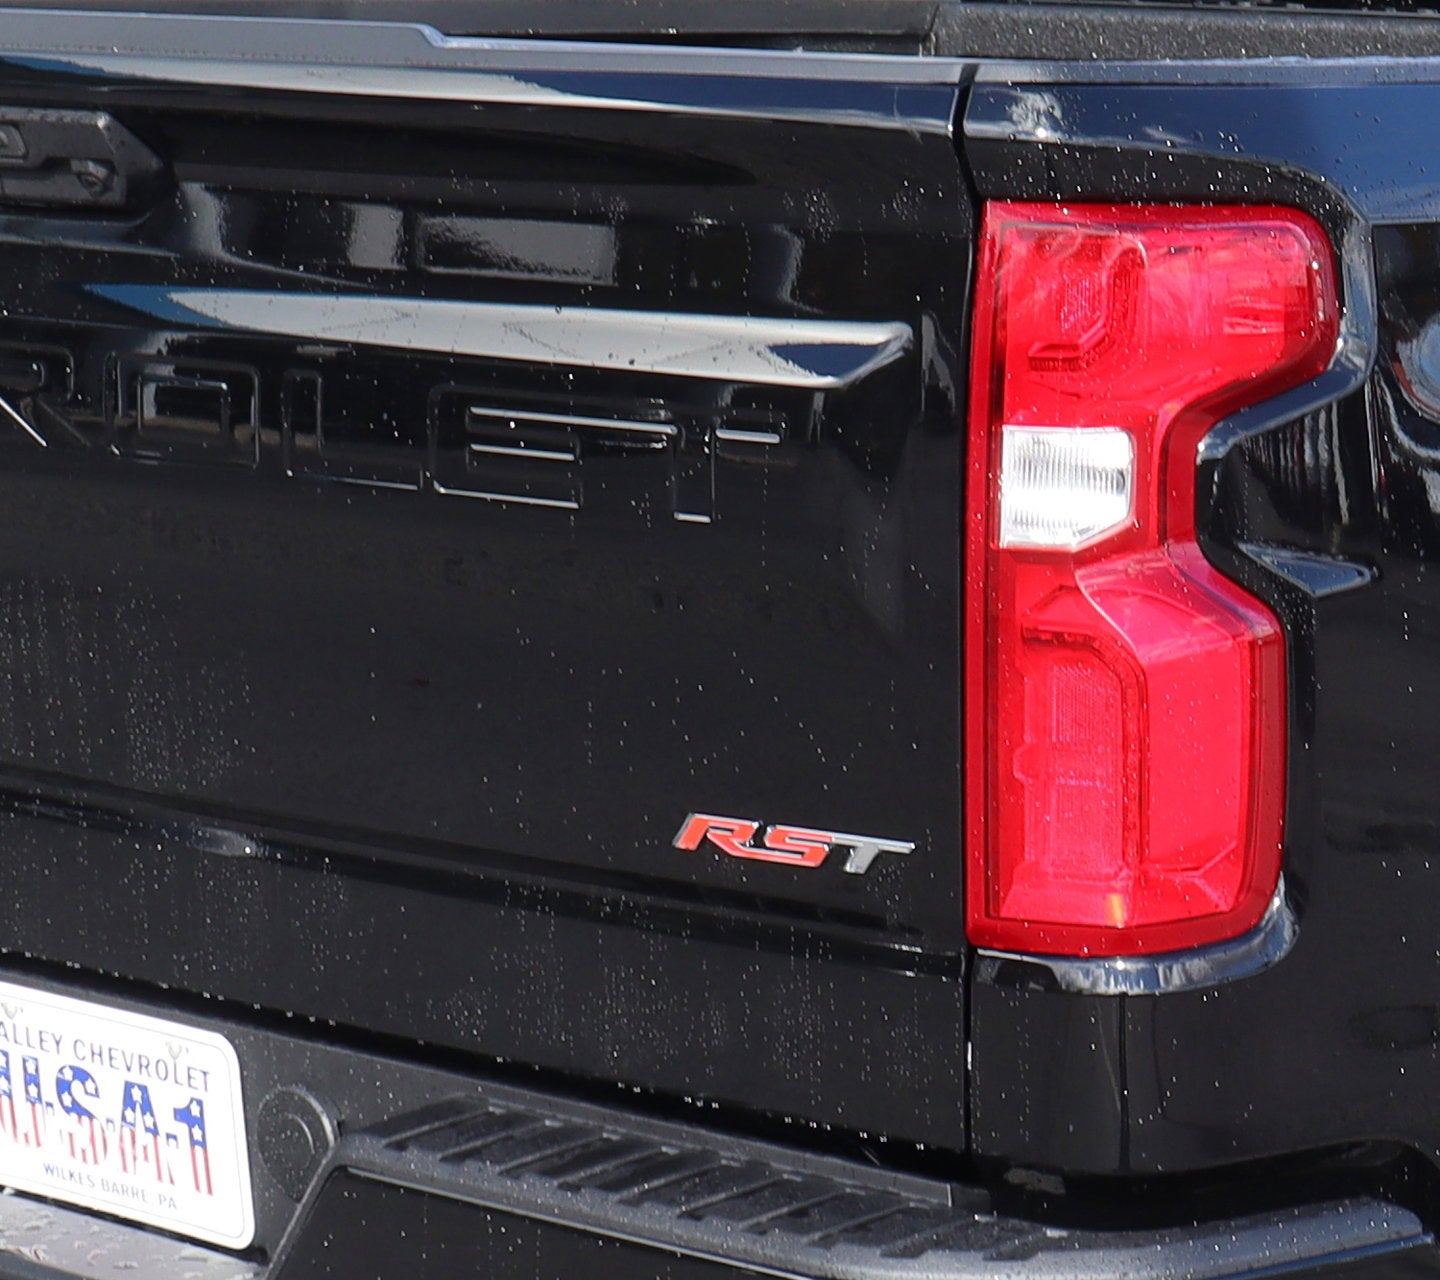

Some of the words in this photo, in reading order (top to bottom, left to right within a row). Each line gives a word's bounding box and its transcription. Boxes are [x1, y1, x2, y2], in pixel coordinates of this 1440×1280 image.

[671, 812, 916, 875] RST
[73, 1038, 211, 1093] CHEVROLET
[43, 1162, 96, 1188] WILKES
[158, 1194, 178, 1210] PA
